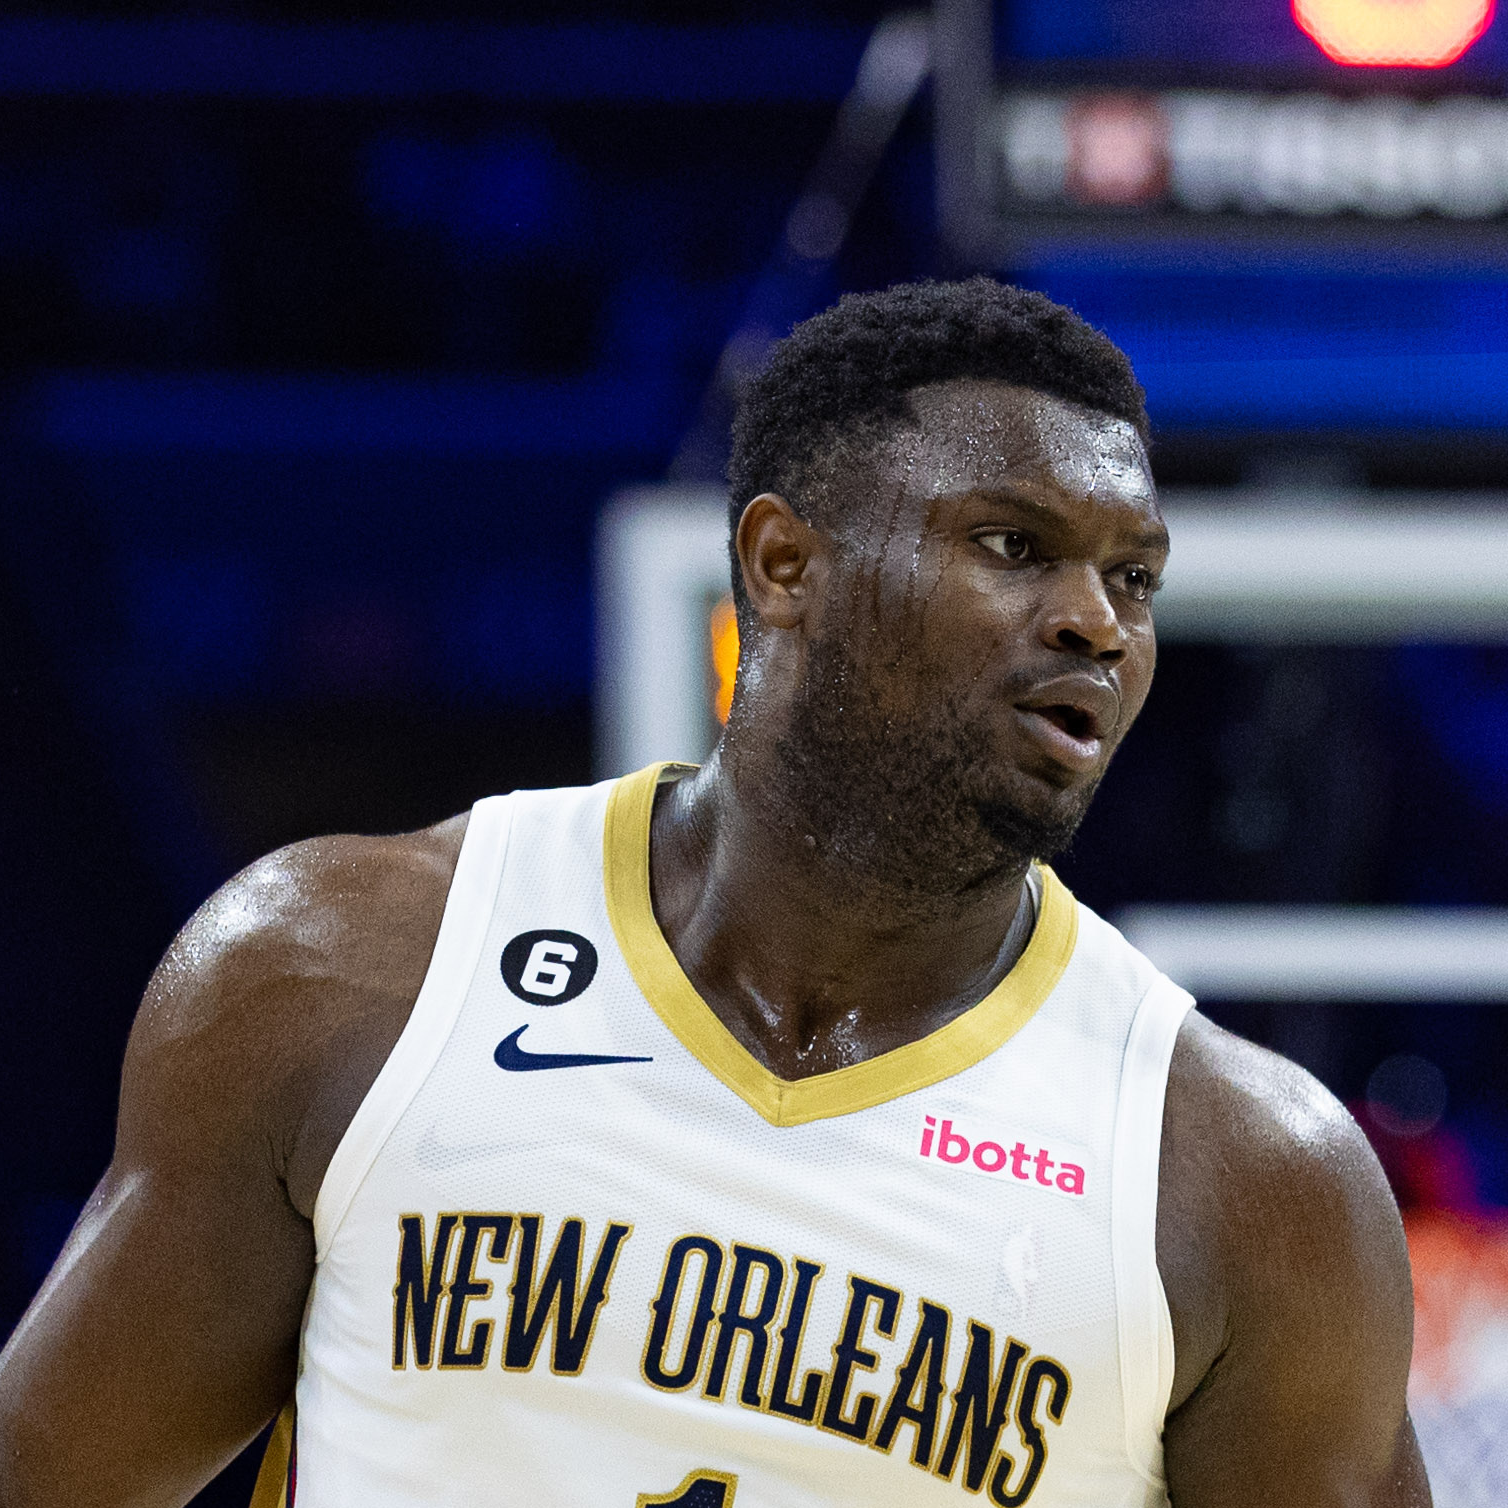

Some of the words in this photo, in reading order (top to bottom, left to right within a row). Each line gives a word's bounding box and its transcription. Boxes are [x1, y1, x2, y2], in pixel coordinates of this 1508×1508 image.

[519, 939, 579, 998] 6
[919, 1114, 1086, 1196] ibotta
[391, 1210, 635, 1377] NEW
